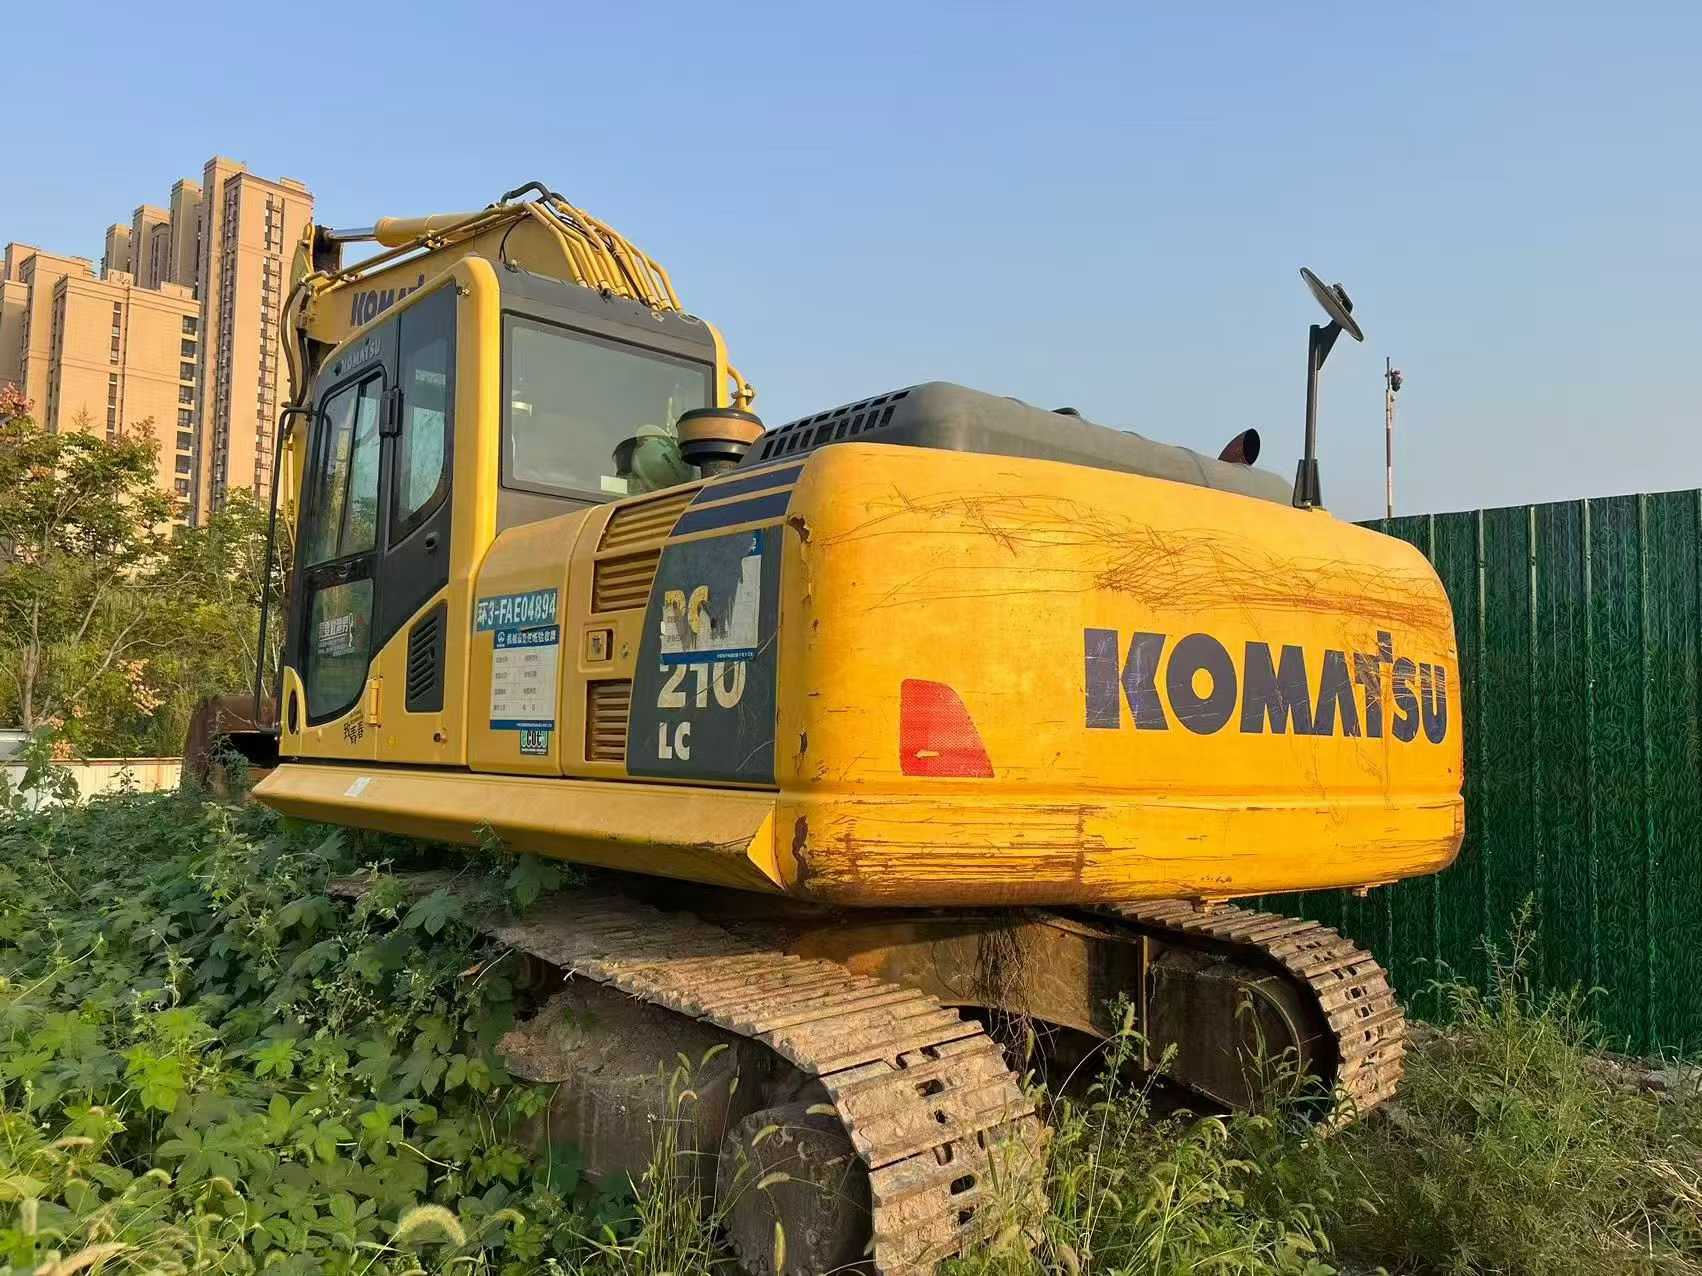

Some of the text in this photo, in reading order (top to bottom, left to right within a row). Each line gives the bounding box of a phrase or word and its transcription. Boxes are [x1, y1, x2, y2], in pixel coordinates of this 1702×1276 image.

[656, 661, 747, 709] 210
[1084, 628, 1446, 744] KOMATSU
[658, 721, 691, 761] LC
